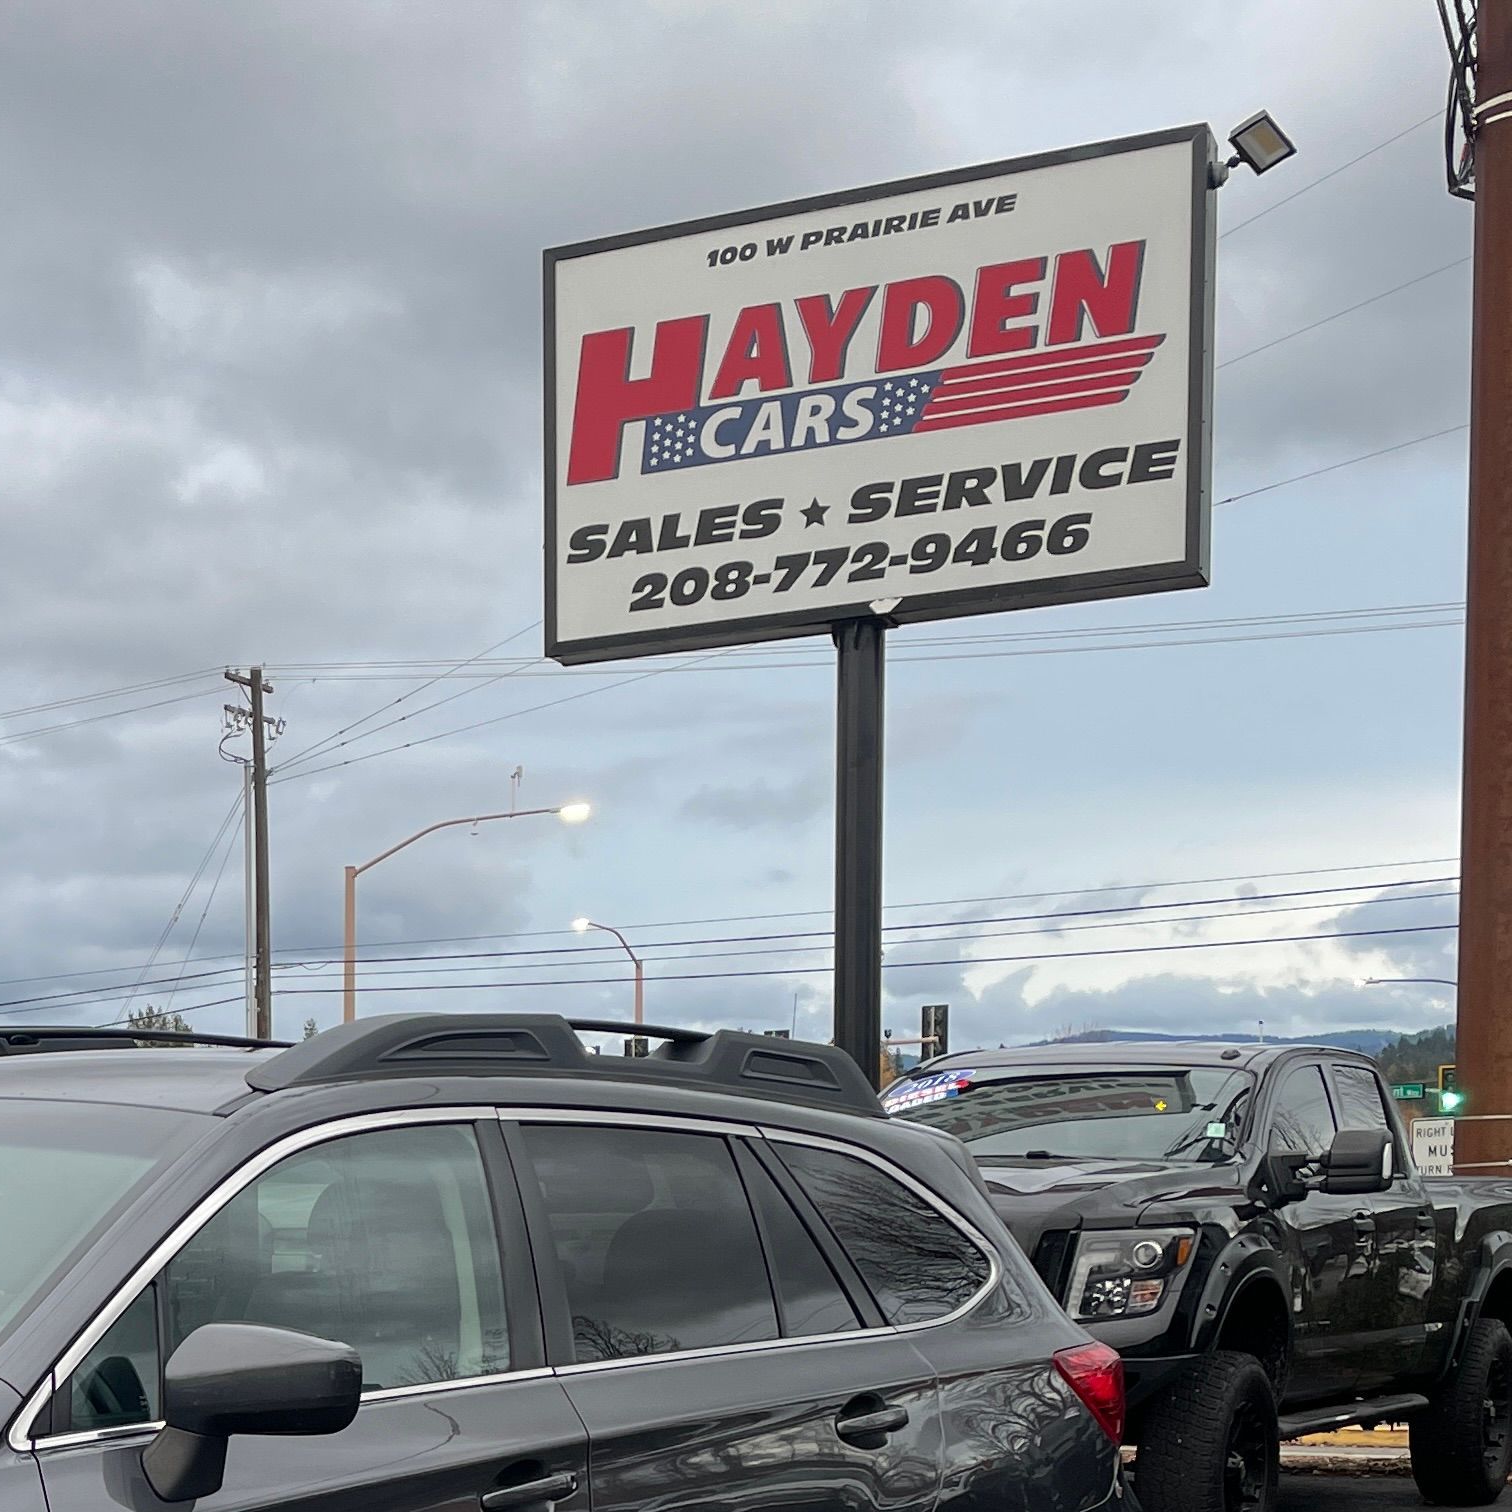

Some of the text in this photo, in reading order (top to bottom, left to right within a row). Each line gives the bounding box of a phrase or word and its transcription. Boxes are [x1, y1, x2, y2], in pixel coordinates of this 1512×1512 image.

[705, 193, 1019, 268] 100 W PRAIRIE AVE
[566, 239, 1147, 486] HAYDEN
[699, 385, 880, 461] CARS
[566, 439, 1181, 564] SALES SERVICE
[628, 512, 1093, 613] 208-772-9466
[1416, 1126, 1446, 1138] RIGHT
